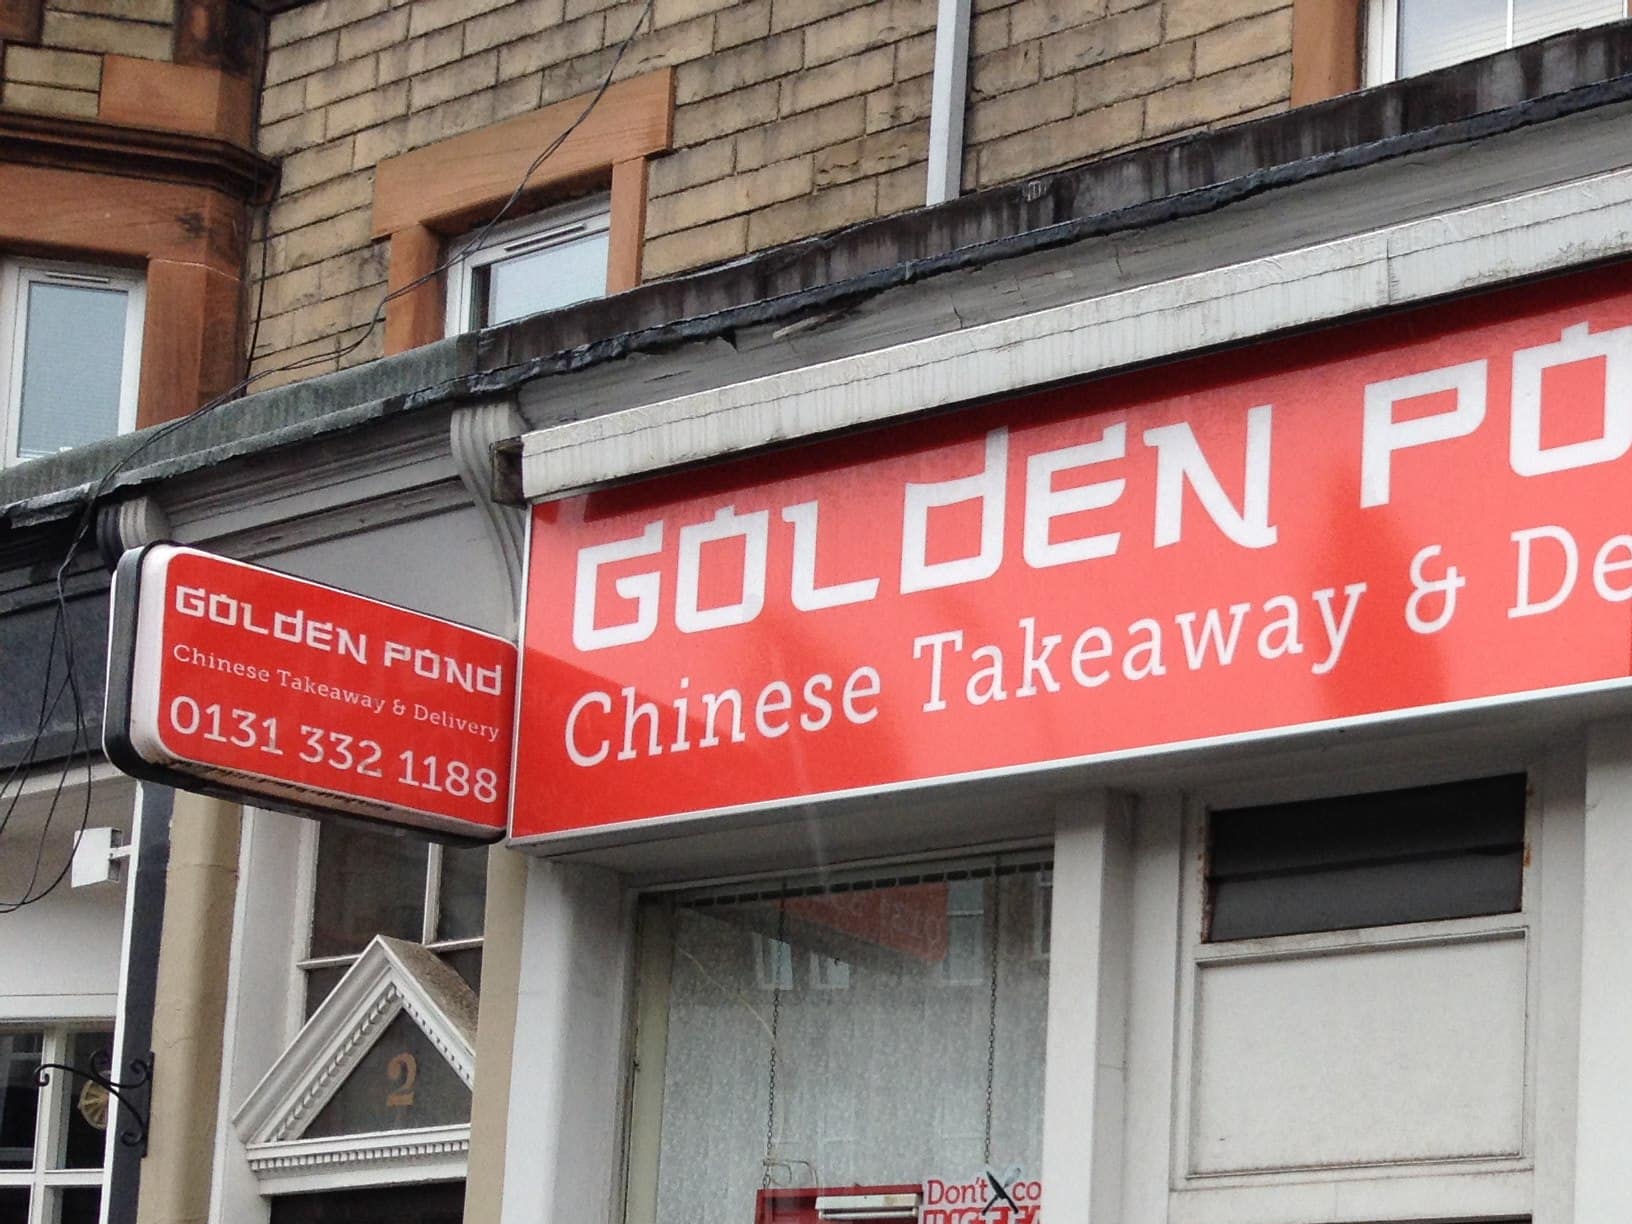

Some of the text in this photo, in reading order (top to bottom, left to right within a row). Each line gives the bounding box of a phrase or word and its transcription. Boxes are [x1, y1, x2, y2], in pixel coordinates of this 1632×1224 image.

[173, 644, 500, 743] Chinese Takeaway & Delivery
[565, 661, 880, 767] Chinese
[912, 581, 1366, 712] Takeaway
[1404, 545, 1465, 635] &
[169, 696, 498, 803] 0131 332 1188
[386, 1052, 417, 1107] 2
[928, 1177, 988, 1205] Don't
